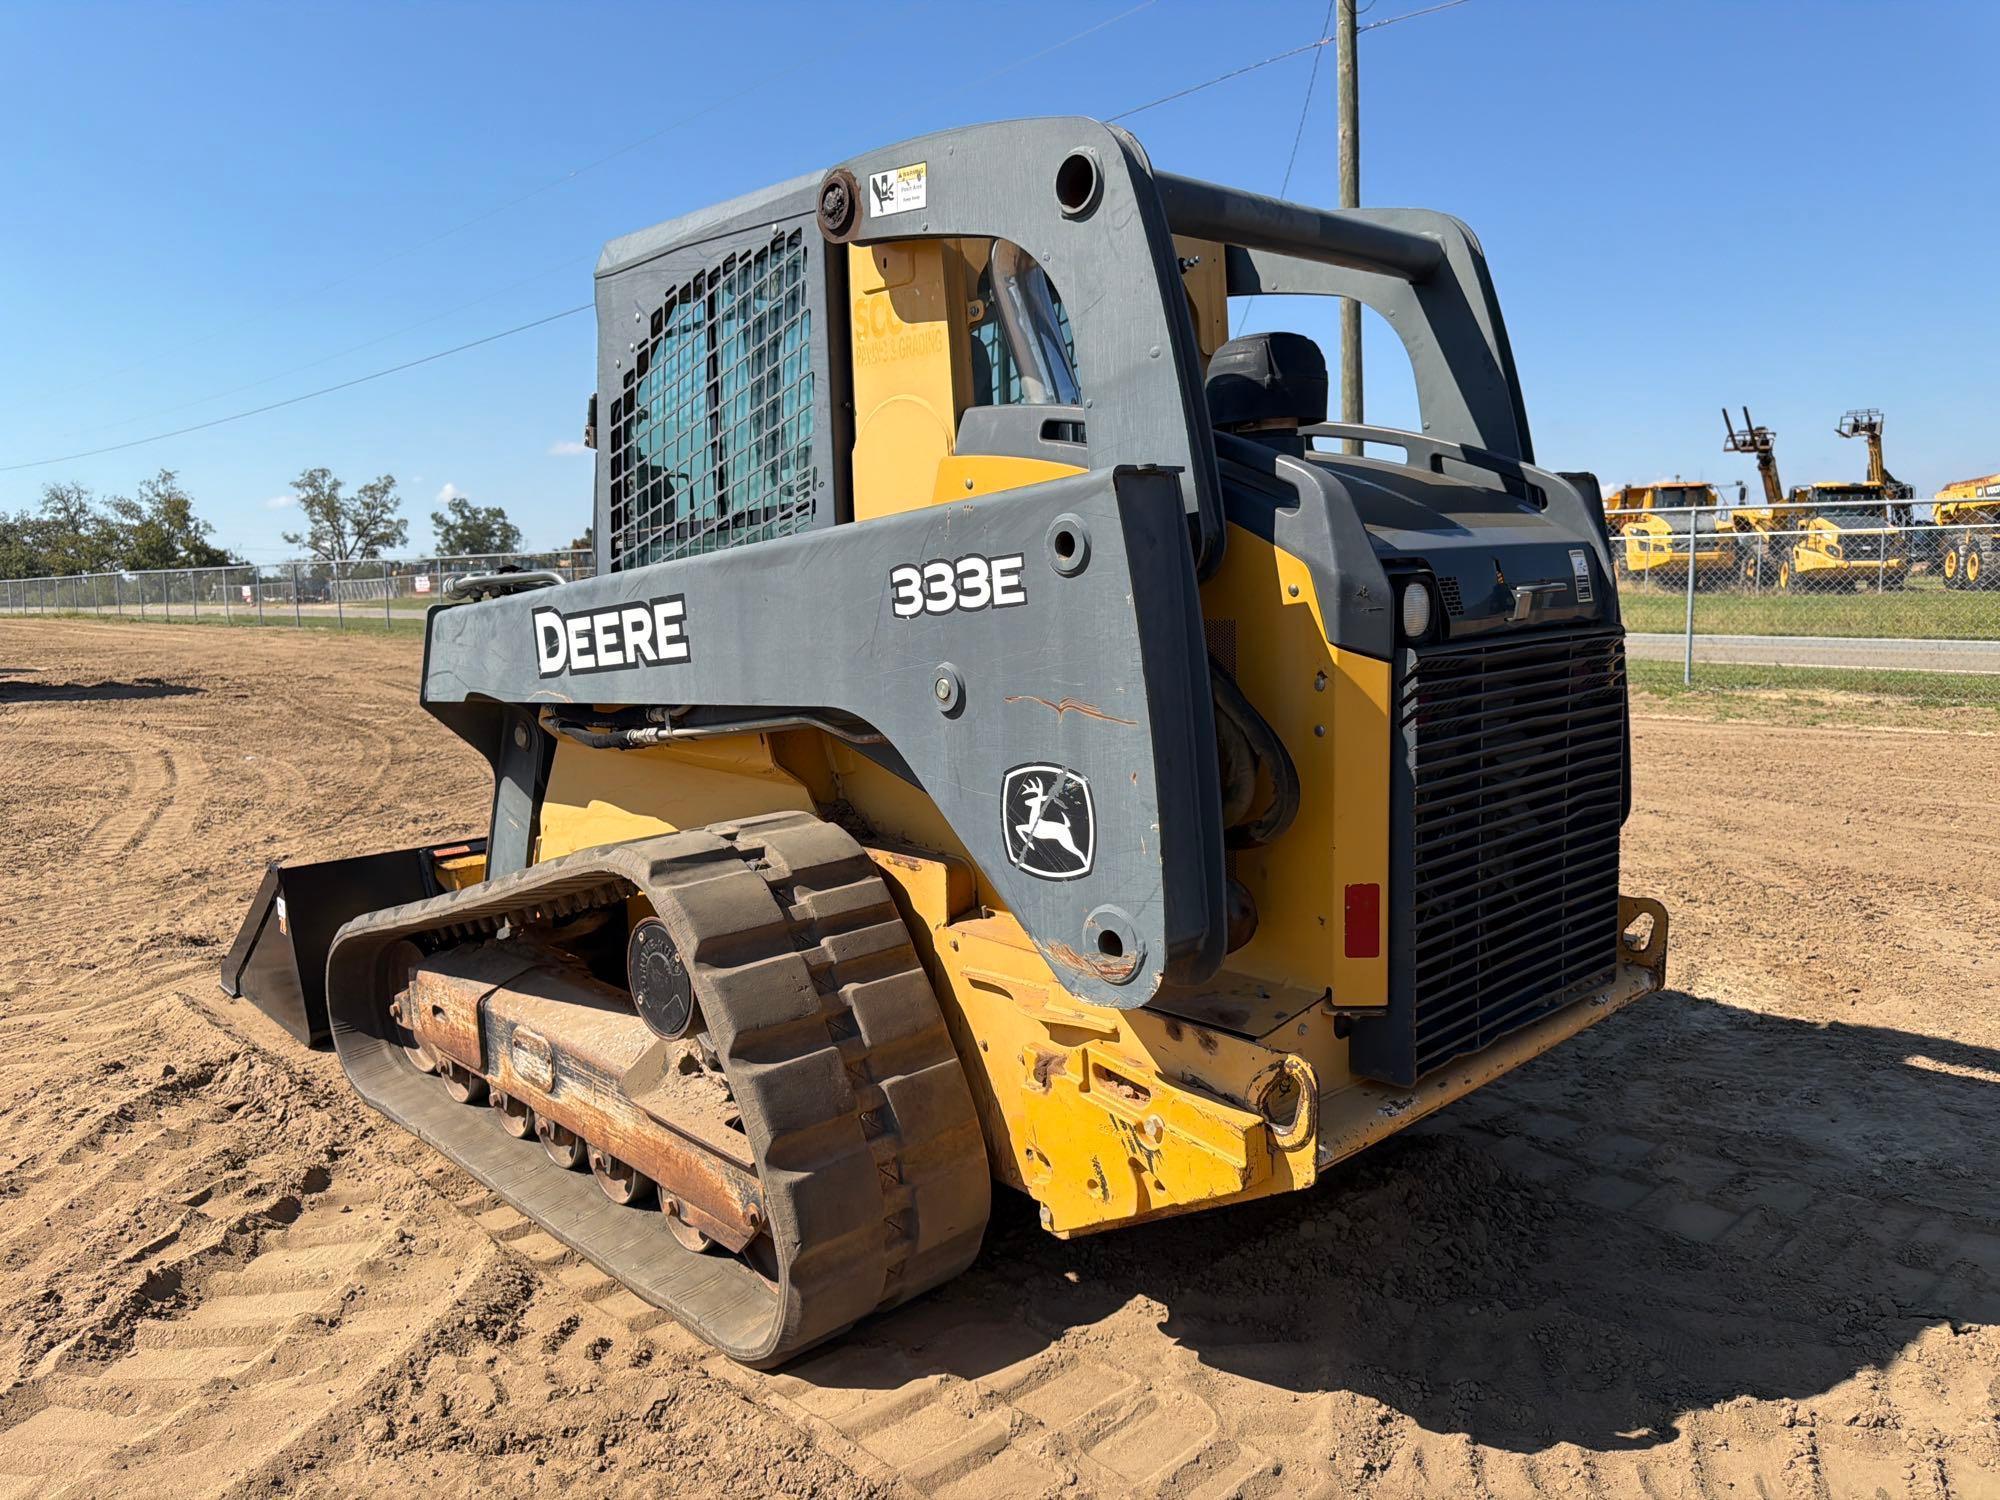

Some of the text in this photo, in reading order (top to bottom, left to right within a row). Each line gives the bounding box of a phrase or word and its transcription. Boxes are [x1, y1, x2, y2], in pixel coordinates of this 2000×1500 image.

[899, 329, 943, 359] GRADING
[891, 554, 1027, 618] 333E
[532, 598, 690, 676] DEERE
